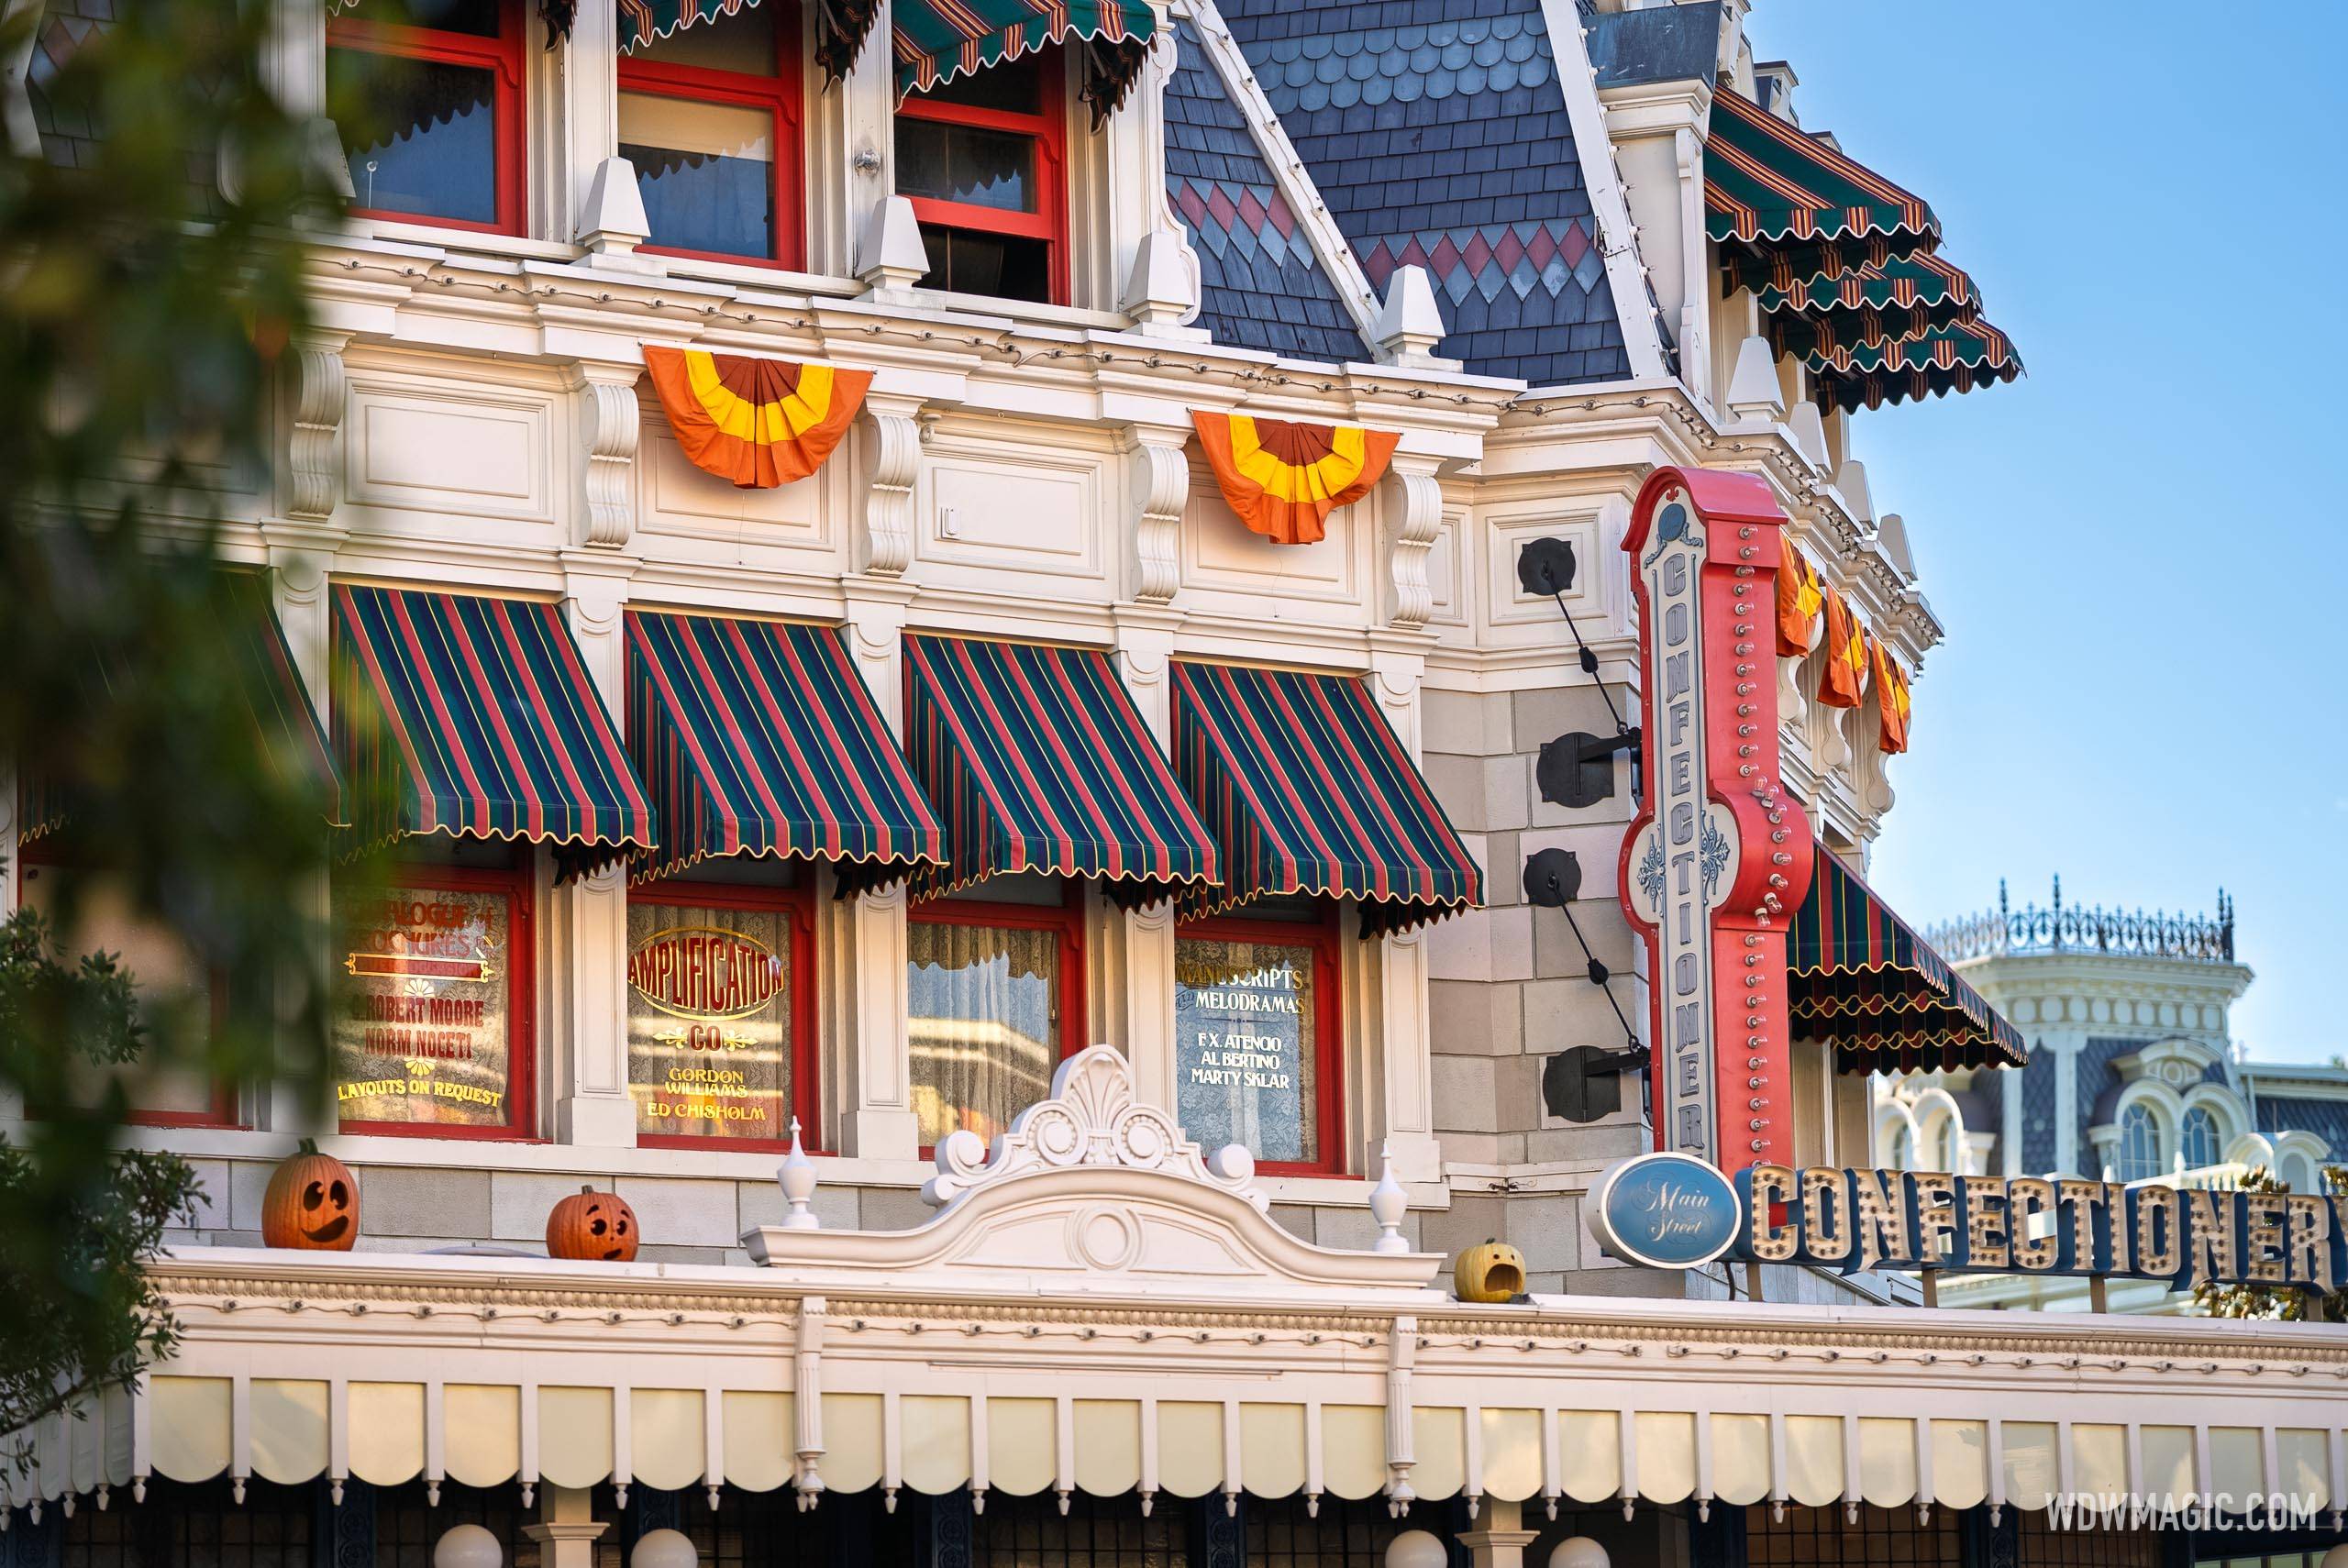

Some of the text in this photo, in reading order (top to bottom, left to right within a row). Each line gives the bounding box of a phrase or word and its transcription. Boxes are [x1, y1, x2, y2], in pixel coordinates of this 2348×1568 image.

[1662, 552, 1705, 1158] CONFECTIONER
[627, 937, 784, 1013] AMPLIFICATION
[366, 994, 426, 1024] ROBERT
[429, 999, 484, 1027] MOORE
[1195, 990, 1306, 1015] MELODRAMAS
[365, 1028, 471, 1059] NORM NOCETI
[690, 1024, 723, 1053] CO
[1224, 1034, 1282, 1052] ATENCIO
[1201, 1050, 1280, 1070] AL BERTINO
[664, 1081, 748, 1099] WILLIAMS
[669, 1067, 744, 1084] GORDON
[1191, 1068, 1290, 1089] MARTY SKLAR
[338, 1079, 502, 1108] LAYOUTS ON REQUEST
[647, 1102, 766, 1121] ED CHISHOLM
[1646, 1180, 1711, 1212] Main
[1651, 1211, 1703, 1242] Street
